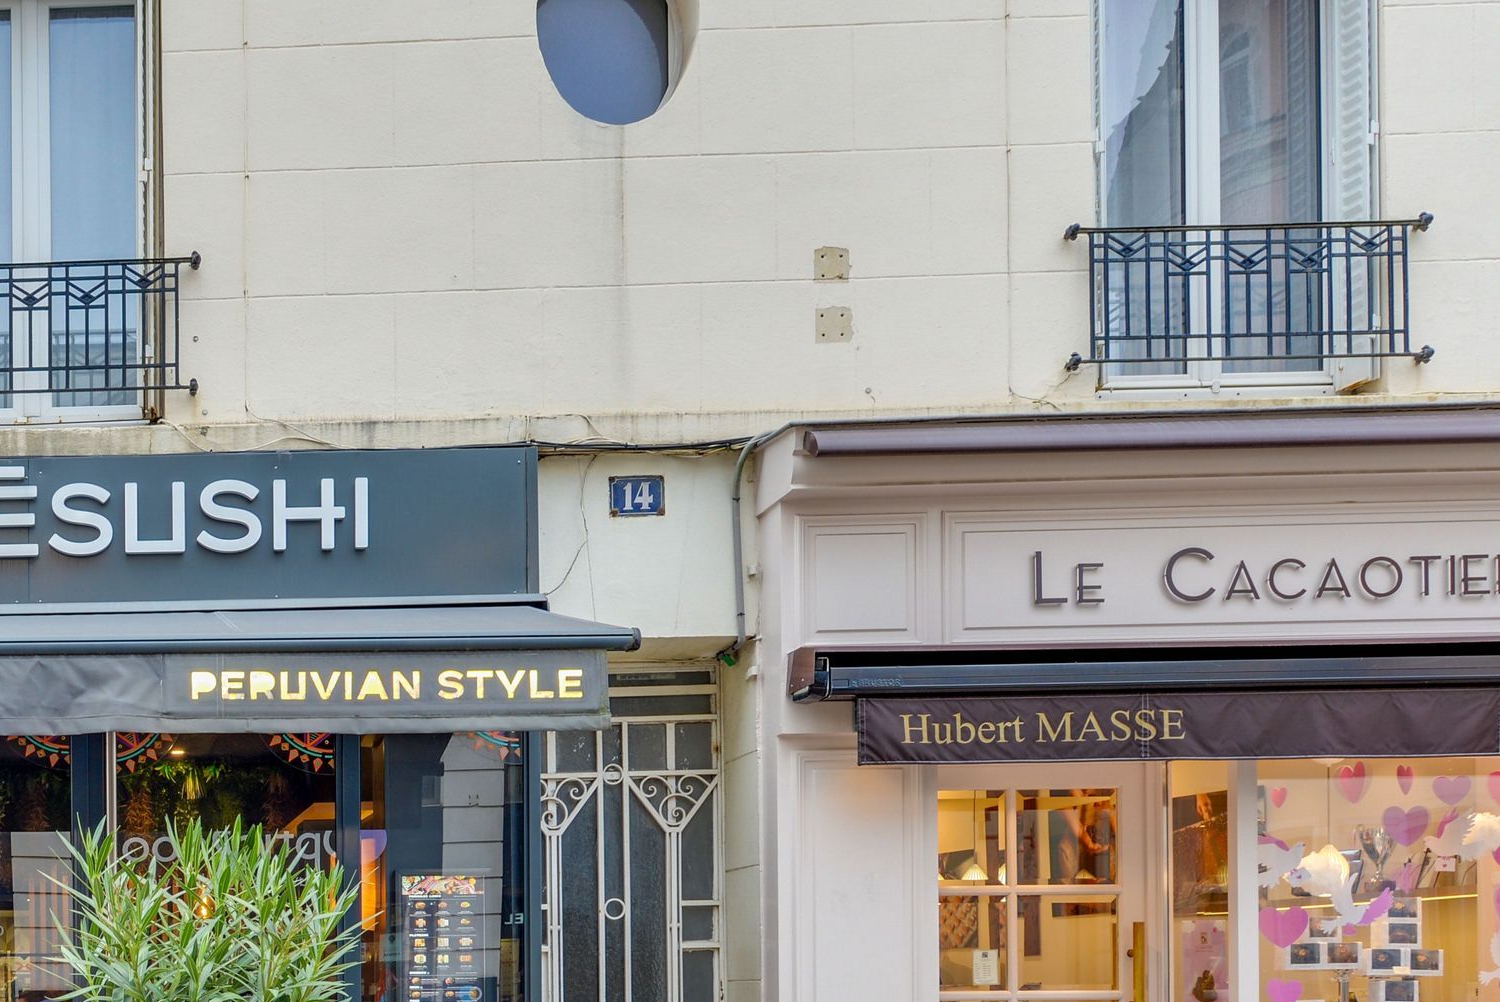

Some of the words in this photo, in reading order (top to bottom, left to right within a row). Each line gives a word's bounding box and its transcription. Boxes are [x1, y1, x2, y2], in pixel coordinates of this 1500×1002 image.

[623, 481, 654, 511] 14
[1032, 550, 1105, 607] LE
[1162, 547, 1500, 604] CACAOTIE
[190, 668, 421, 703] PERUVIAN
[437, 667, 585, 702] STYLE
[900, 710, 1025, 745] Hubert
[1035, 708, 1187, 743] MASSE
